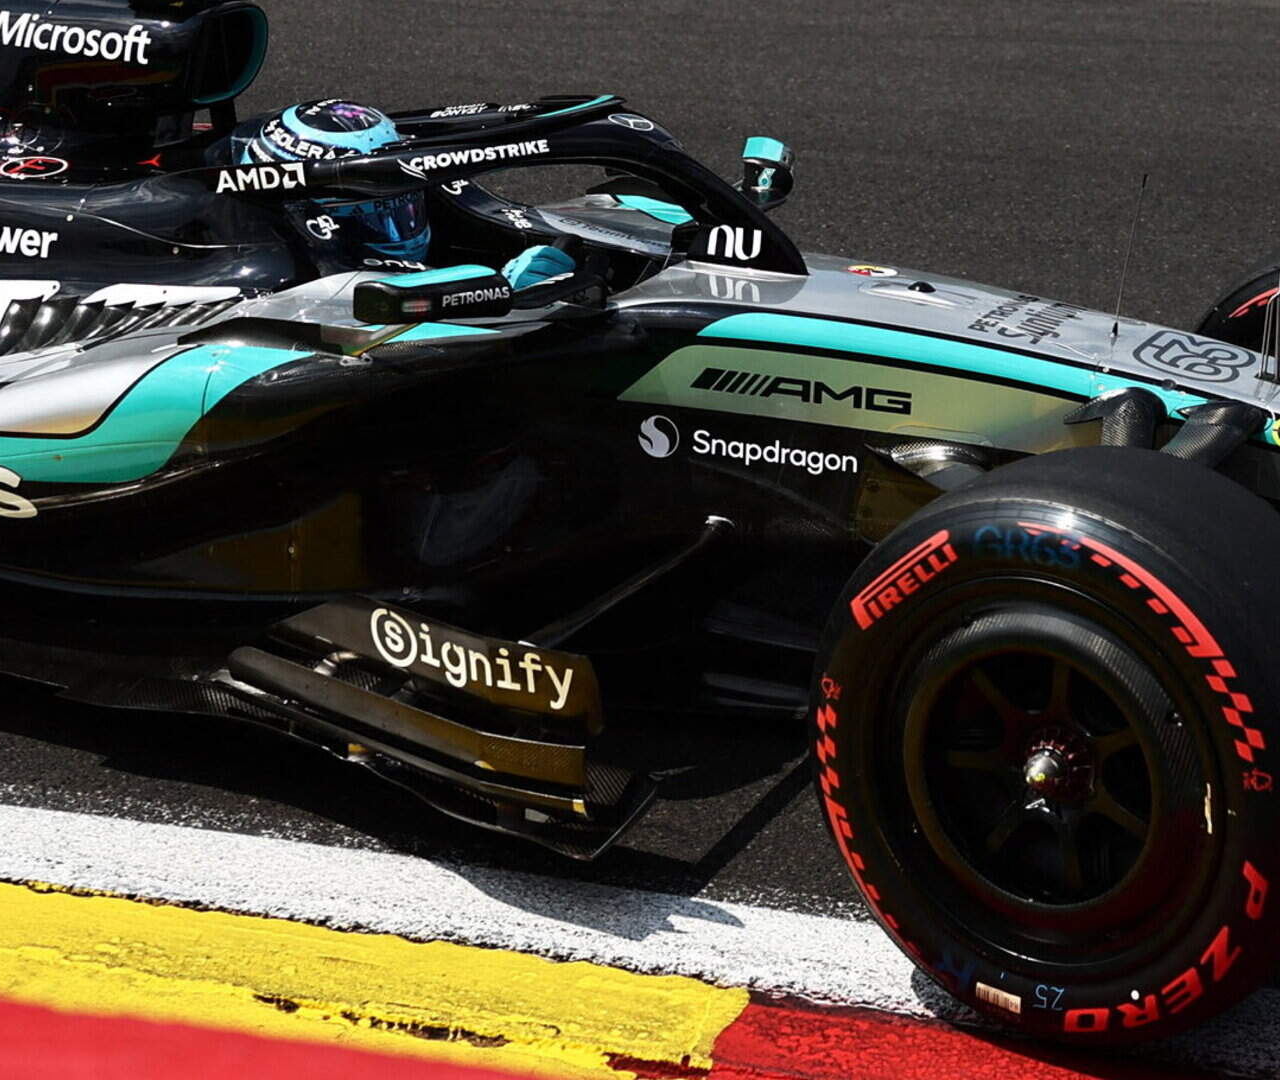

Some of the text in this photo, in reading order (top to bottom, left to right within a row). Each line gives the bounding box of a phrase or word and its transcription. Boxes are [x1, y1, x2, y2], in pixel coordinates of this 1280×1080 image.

[410, 139, 550, 171] CROWDSTRIKE
[216, 166, 281, 193] AMD
[707, 224, 762, 261] nu
[442, 285, 511, 308] PETRONAS
[760, 376, 912, 415] AMG
[691, 429, 858, 475] Snapdragon
[850, 529, 958, 631] PIRELLI
[1242, 861, 1269, 920] P
[1063, 925, 1242, 1034] ZERO
